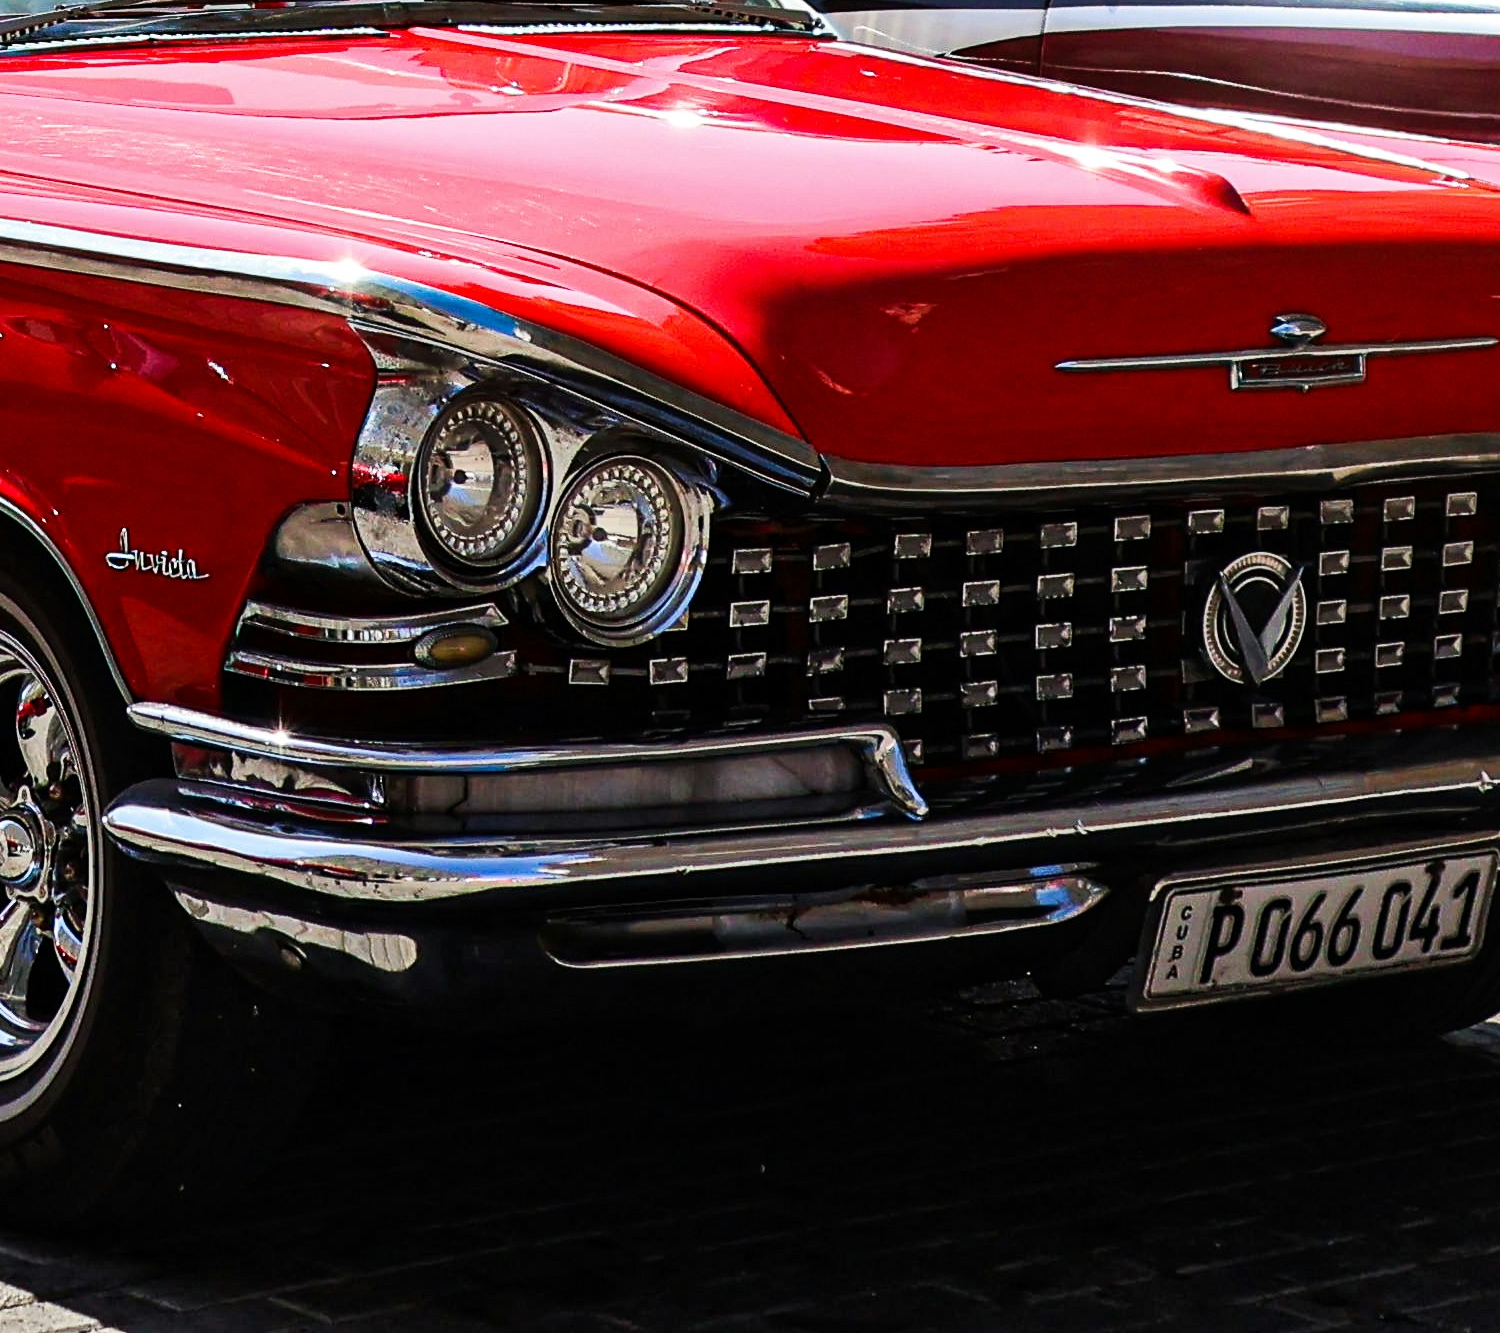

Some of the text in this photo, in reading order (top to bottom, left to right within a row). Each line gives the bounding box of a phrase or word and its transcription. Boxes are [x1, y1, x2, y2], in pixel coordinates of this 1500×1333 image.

[105, 527, 210, 580] Invicta
[1166, 904, 1194, 981] CUBA
[1199, 903, 1245, 985] P
